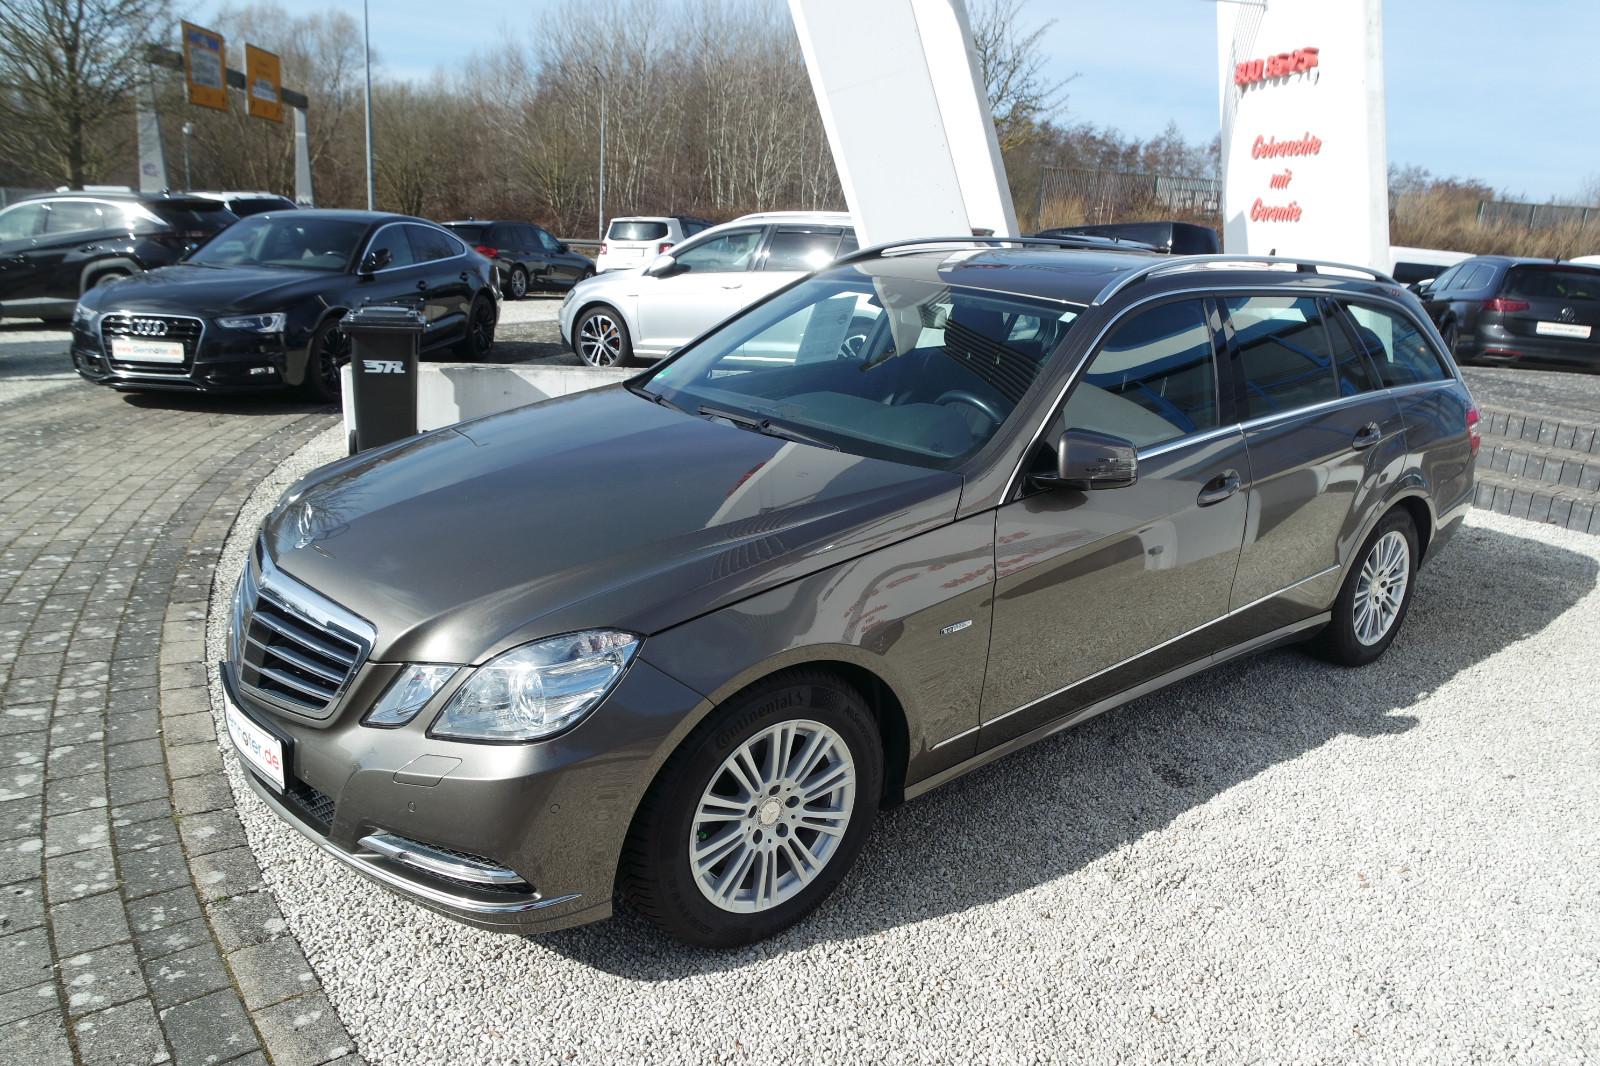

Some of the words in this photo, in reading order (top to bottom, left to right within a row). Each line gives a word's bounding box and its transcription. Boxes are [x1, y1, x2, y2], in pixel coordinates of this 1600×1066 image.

[1251, 131, 1322, 160] Gebrauchte
[1269, 168, 1292, 191] mit
[1250, 197, 1302, 223] Garantie
